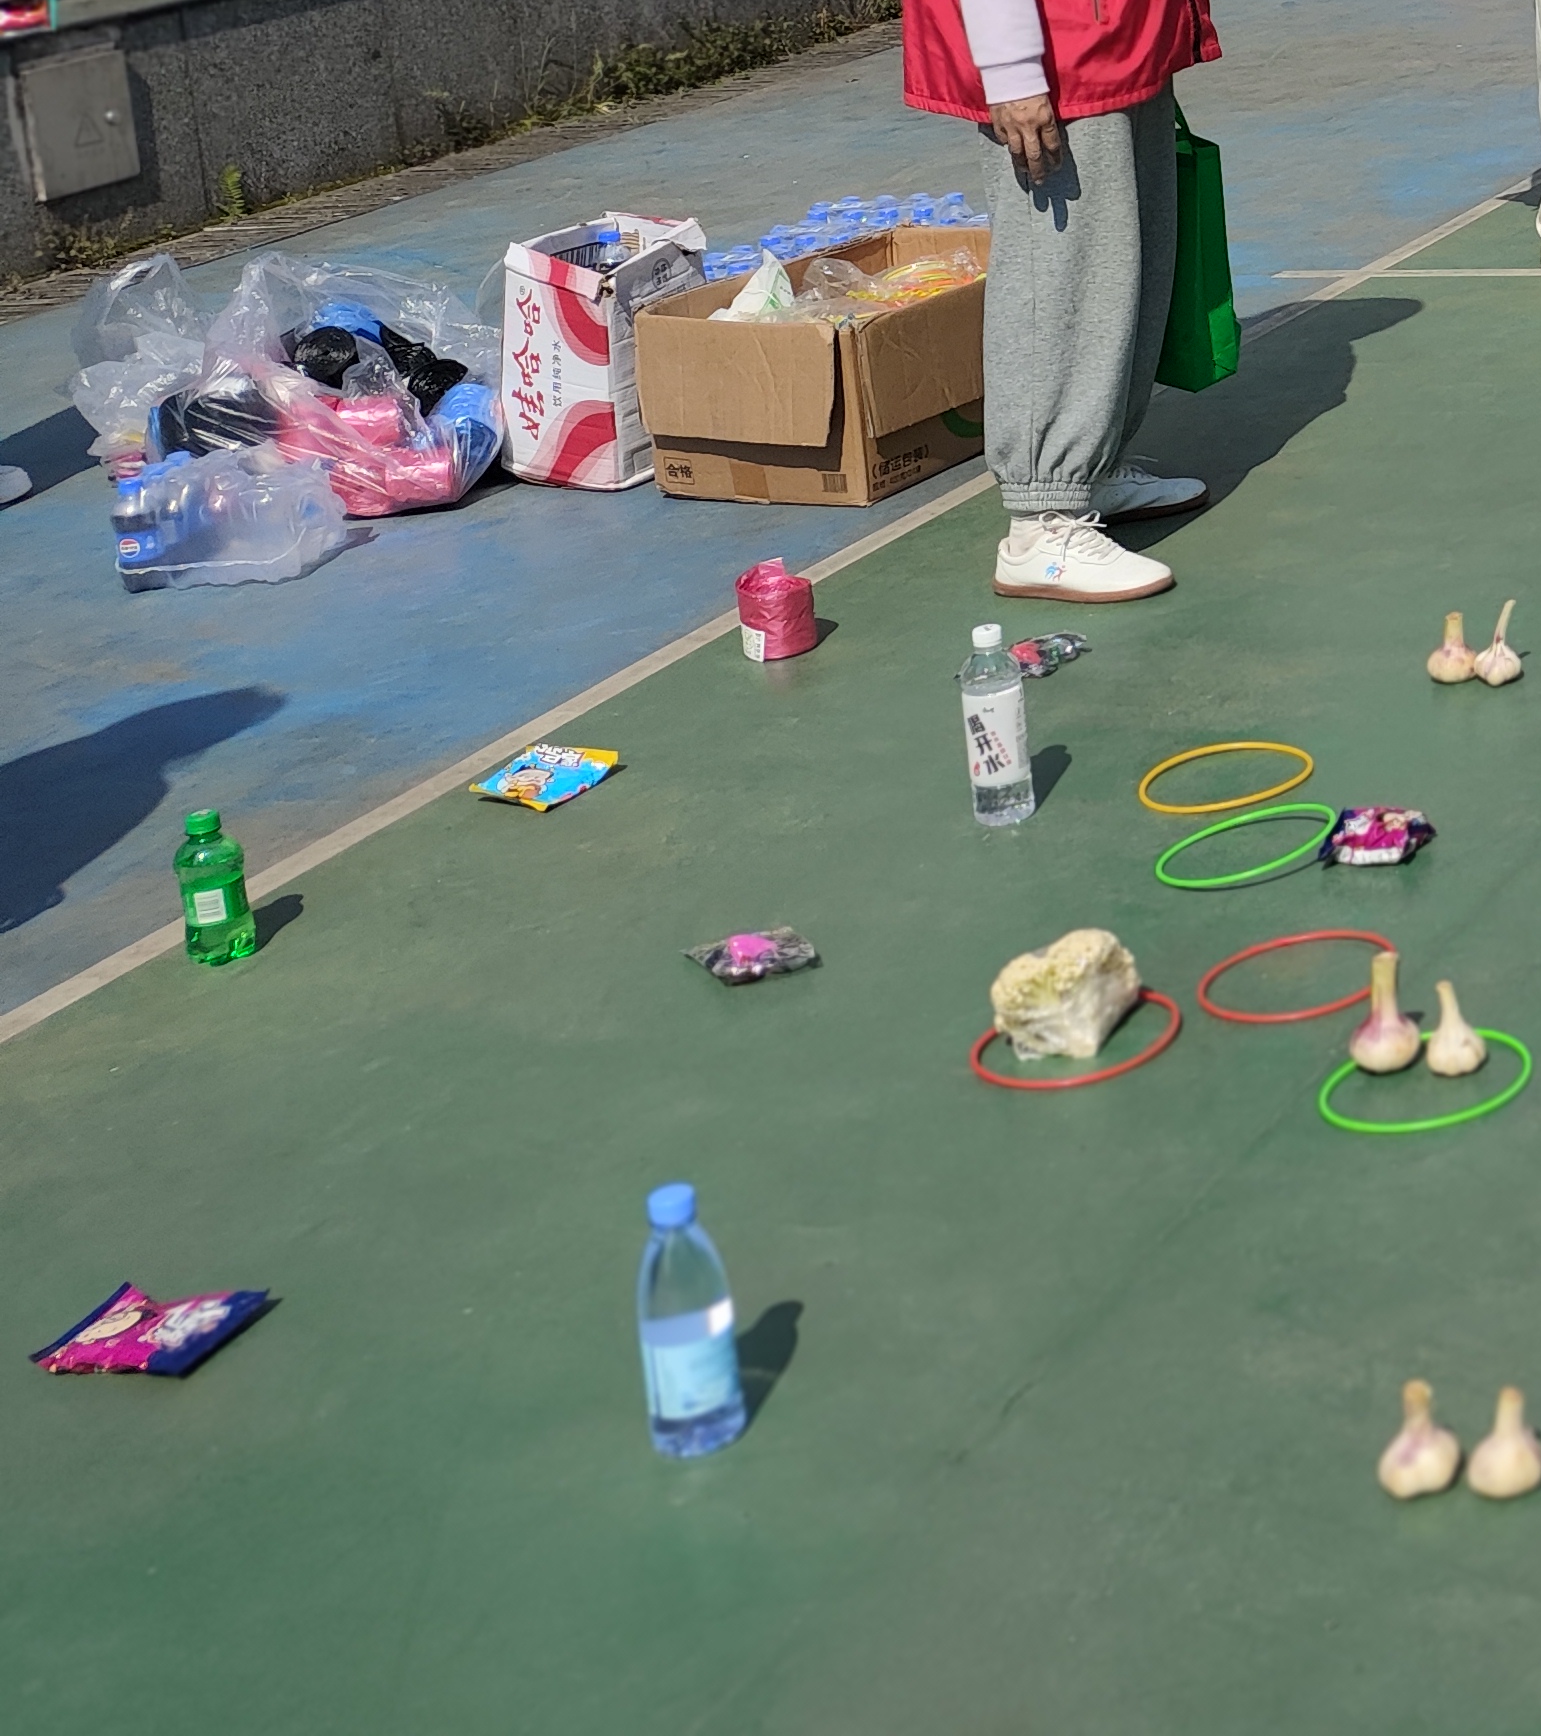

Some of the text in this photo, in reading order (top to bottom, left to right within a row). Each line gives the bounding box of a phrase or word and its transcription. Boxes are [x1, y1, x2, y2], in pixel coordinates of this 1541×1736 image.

[552, 340, 563, 408] 饮用纯净水
[665, 464, 694, 479] 合格
[967, 714, 1006, 775] 喝开水
